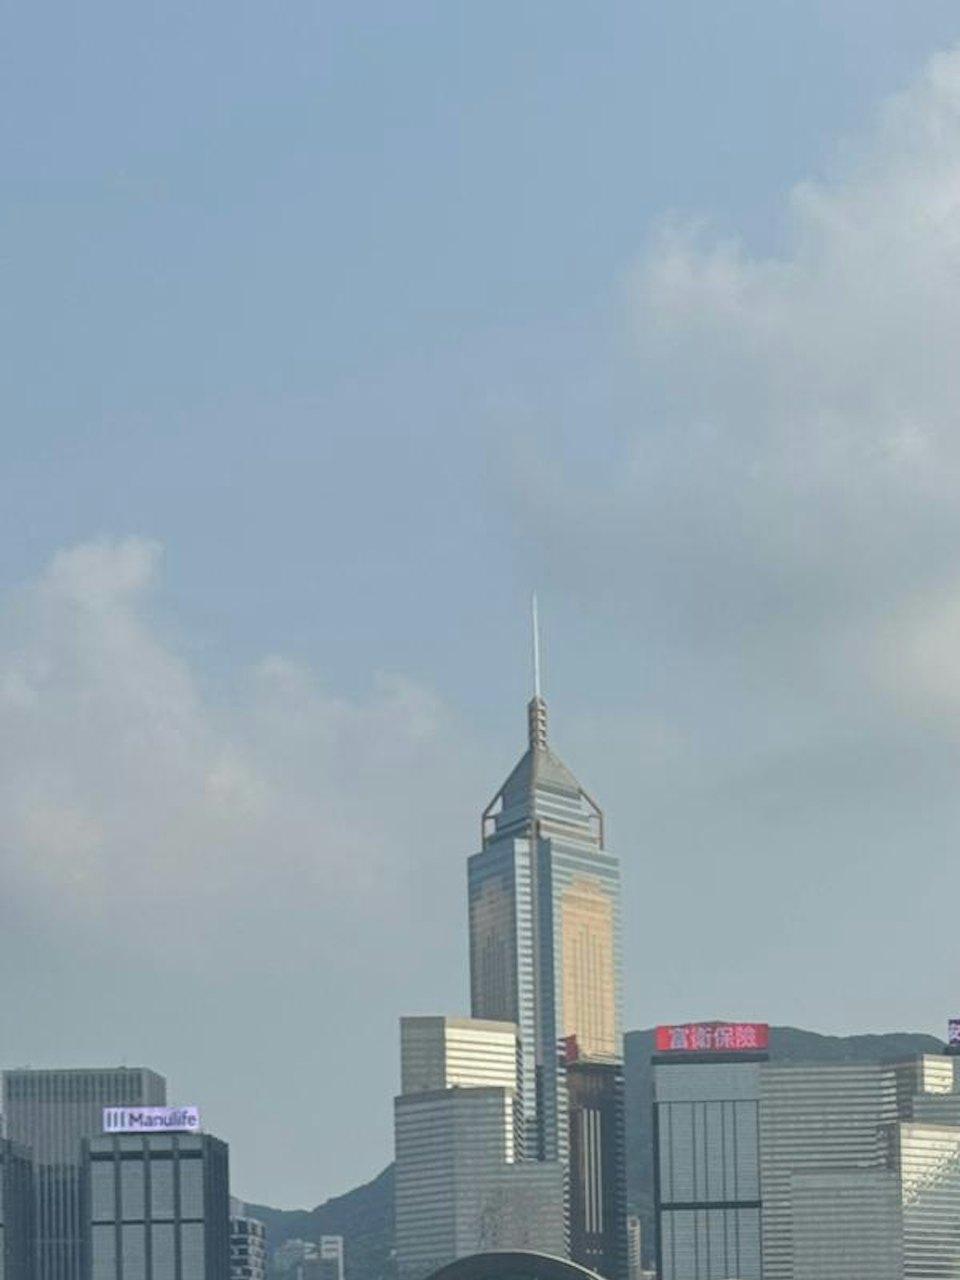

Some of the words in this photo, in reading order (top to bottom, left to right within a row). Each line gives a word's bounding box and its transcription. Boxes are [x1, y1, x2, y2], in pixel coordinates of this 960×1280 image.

[669, 1025, 758, 1051] 富衛保險
[128, 1109, 197, 1128] Manulife
